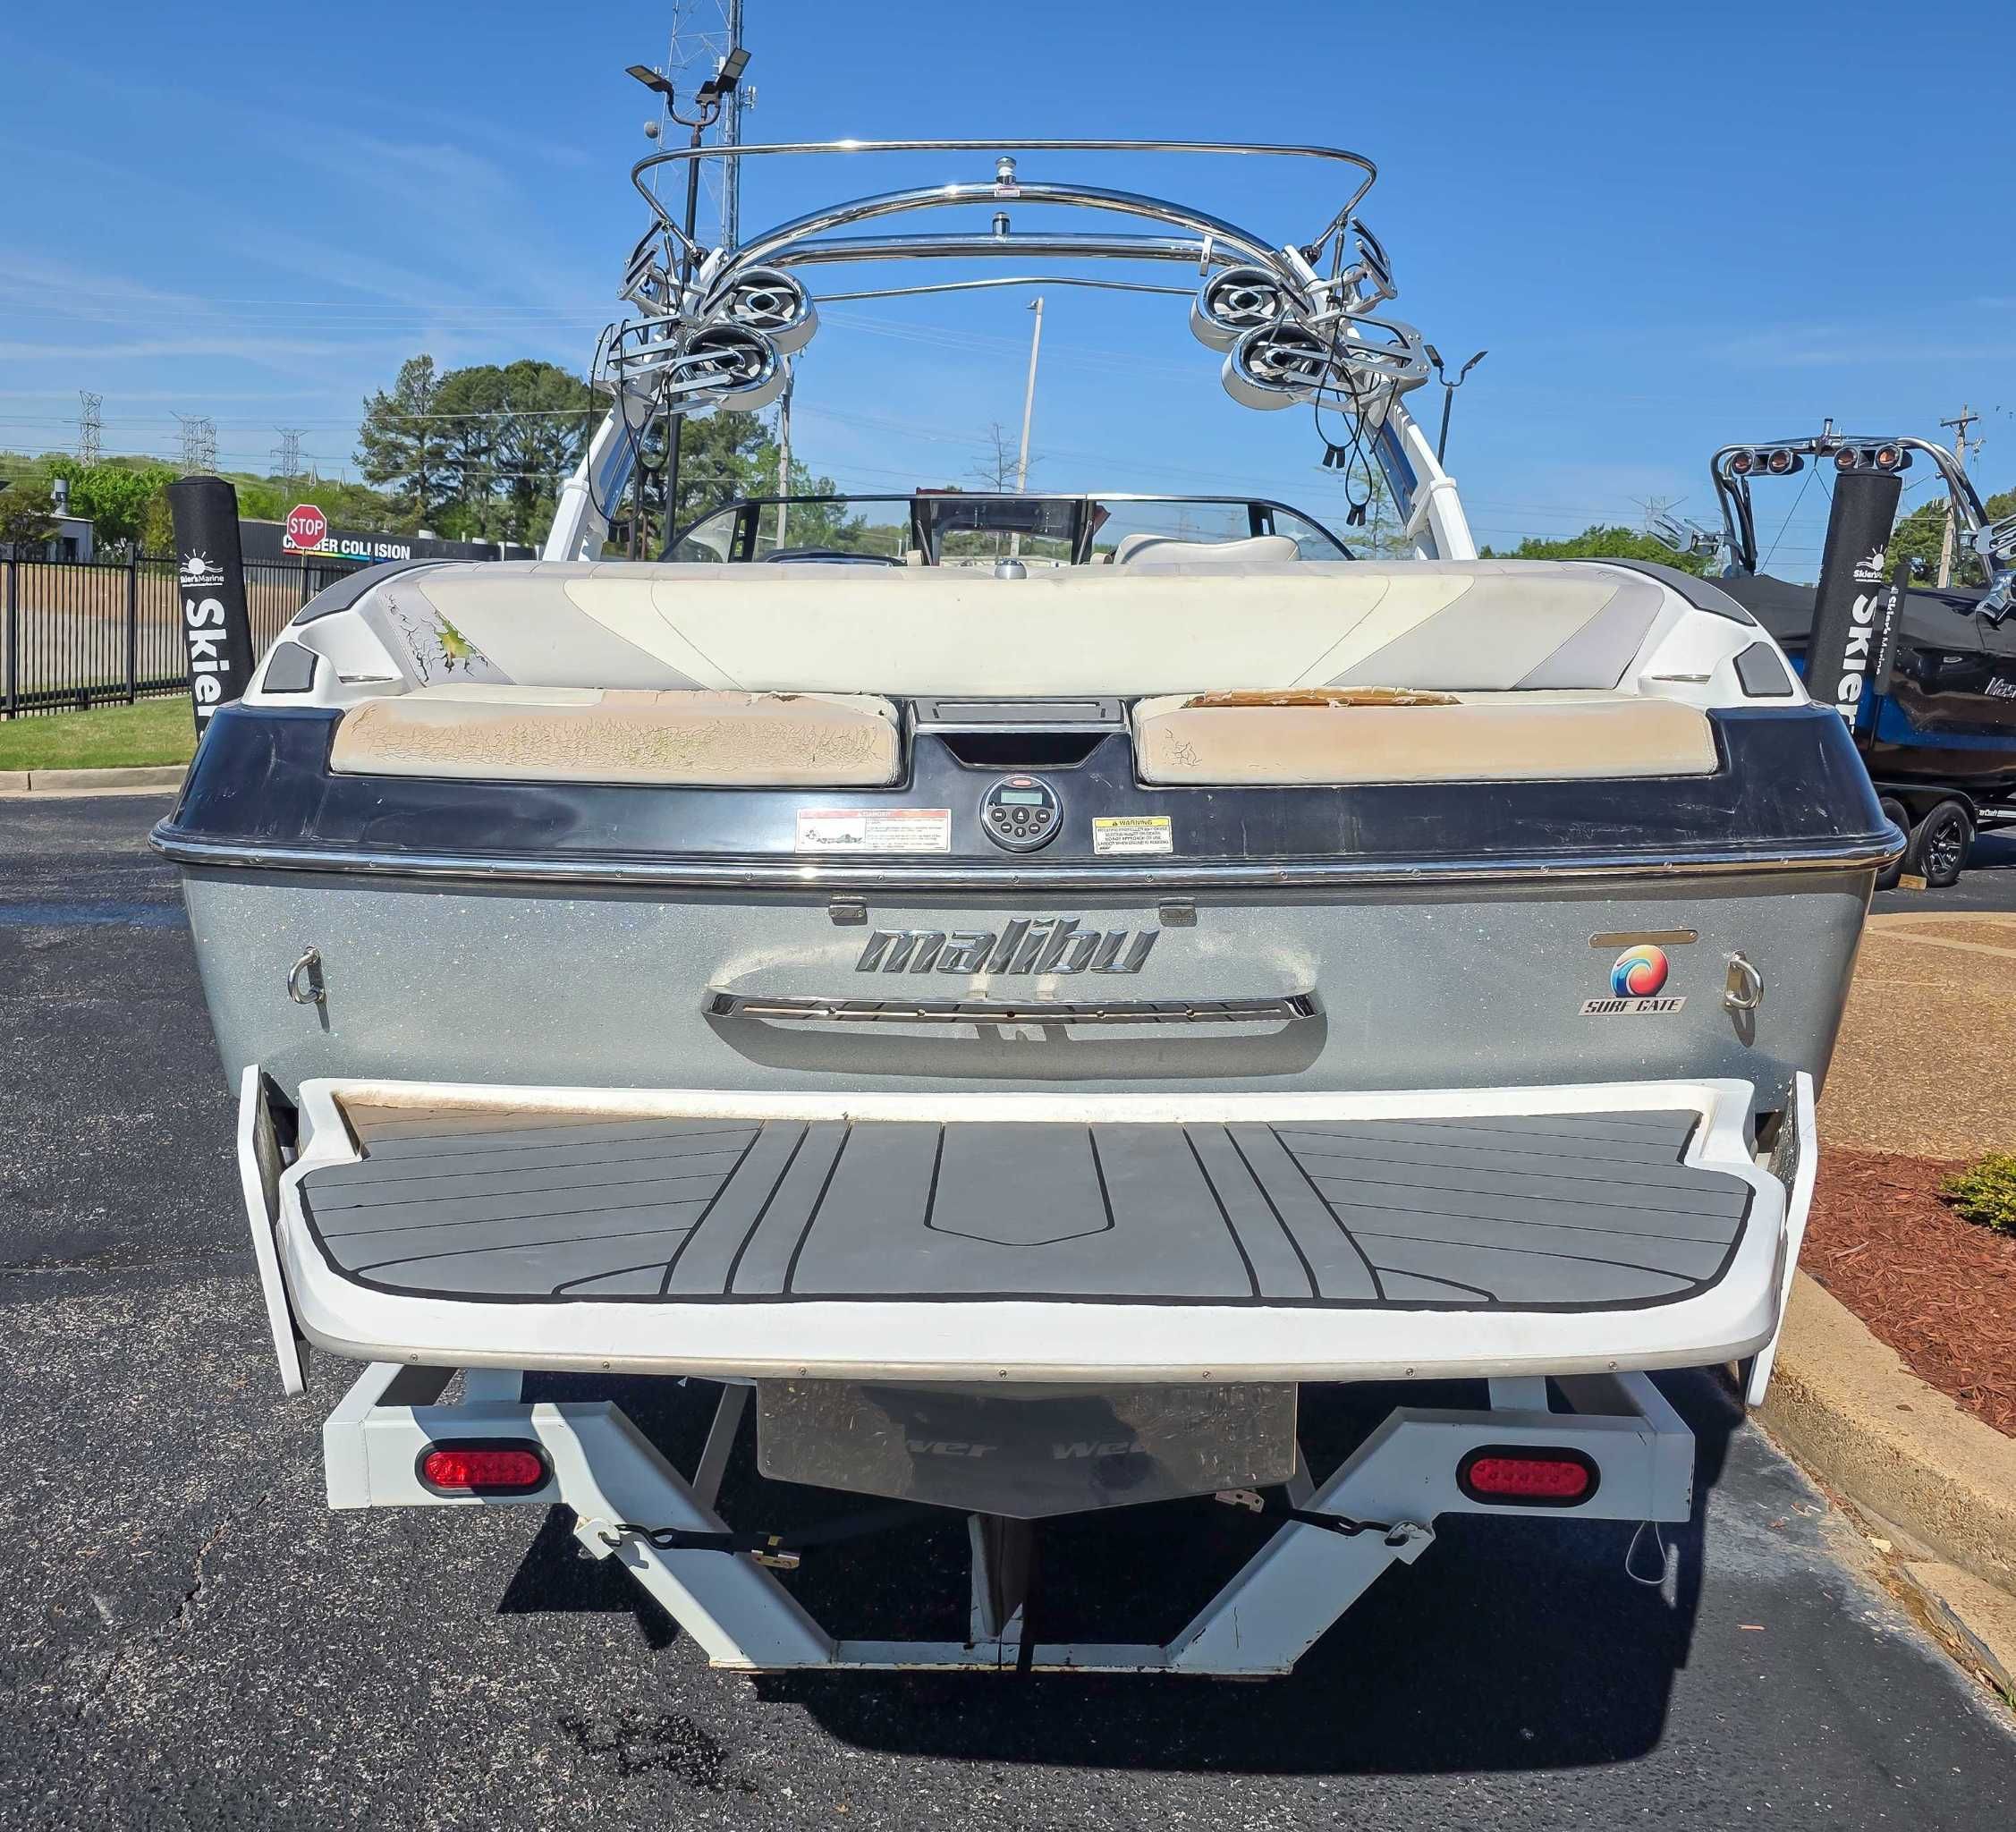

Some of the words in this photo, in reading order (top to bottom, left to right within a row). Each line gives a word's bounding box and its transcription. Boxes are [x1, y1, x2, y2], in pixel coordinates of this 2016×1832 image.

[290, 517, 324, 536] STOP
[283, 534, 338, 553] CBER
[341, 540, 411, 560] COLLISION
[855, 916, 1161, 975] malibu
[1585, 1000, 1634, 1013] SURF
[1636, 998, 1682, 1012] GATE
